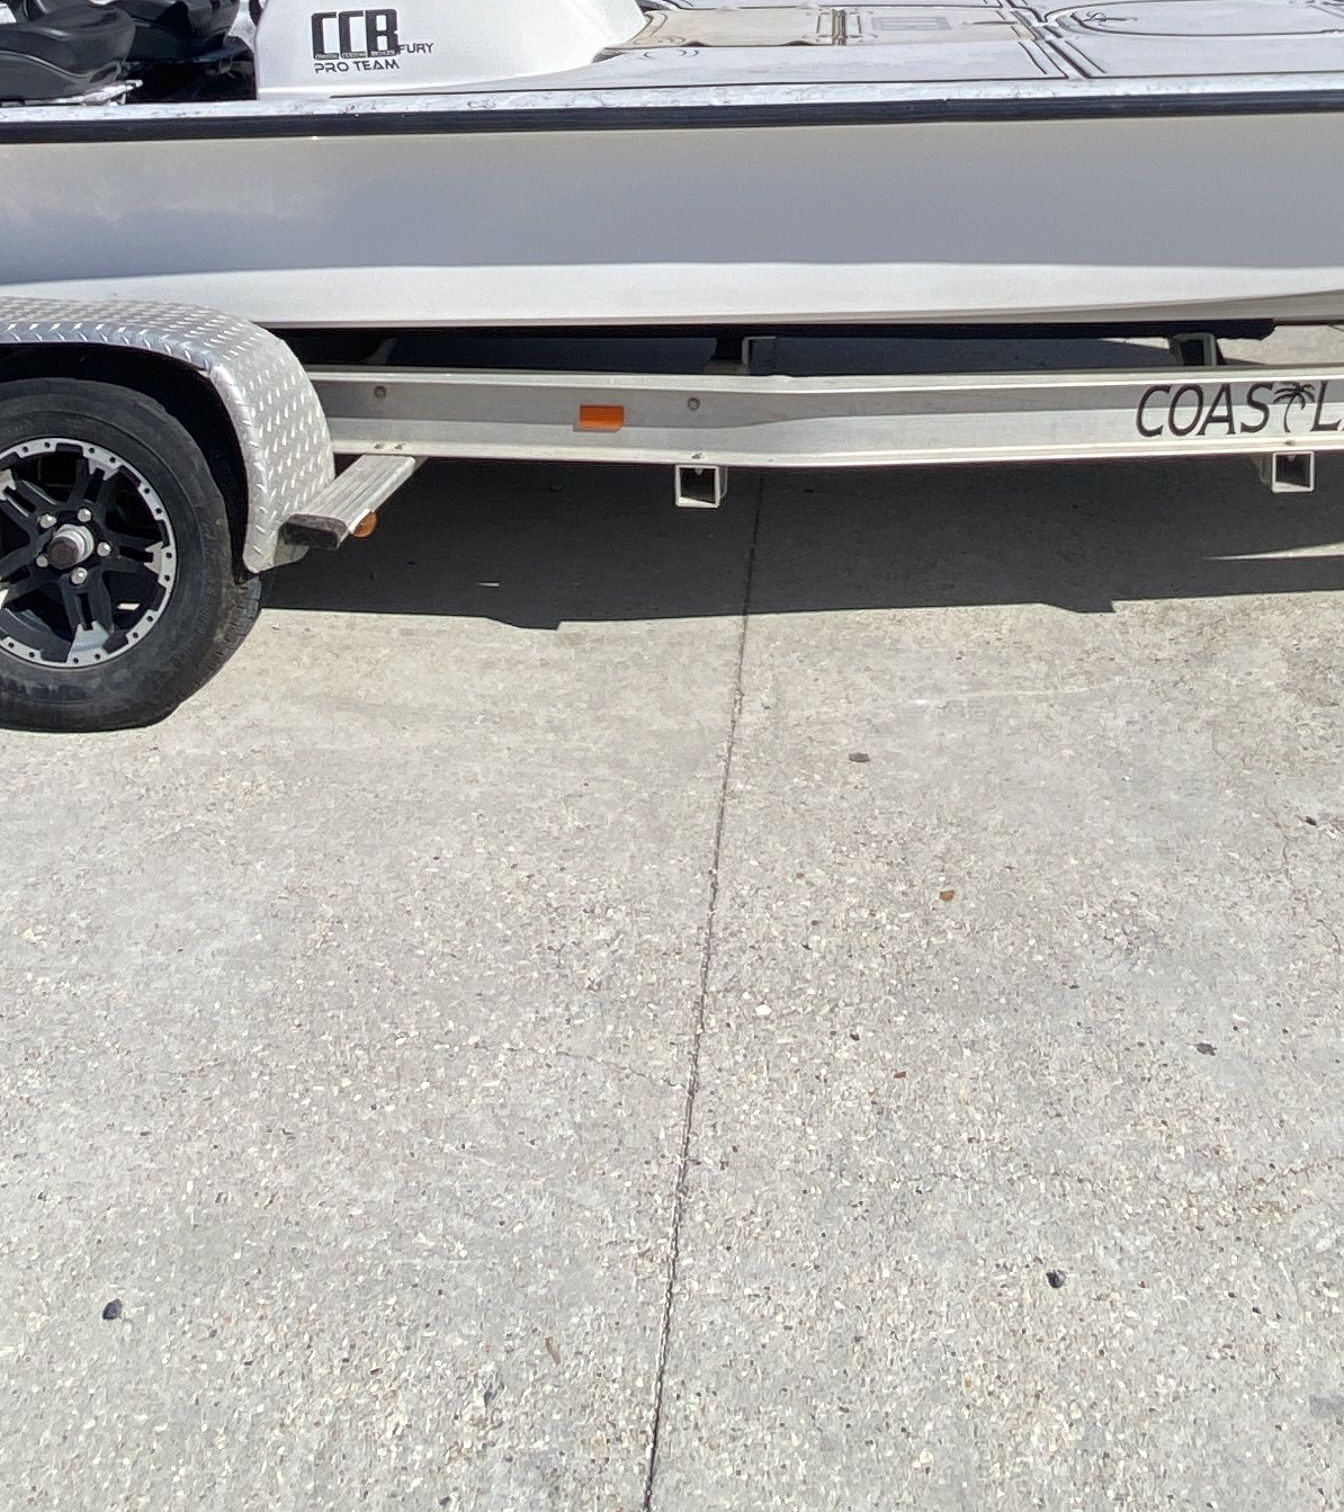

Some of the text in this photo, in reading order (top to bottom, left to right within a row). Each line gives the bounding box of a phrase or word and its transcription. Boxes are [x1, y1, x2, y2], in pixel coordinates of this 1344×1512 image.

[311, 8, 435, 61] CCB FURY
[314, 59, 400, 74] PRO TEAM
